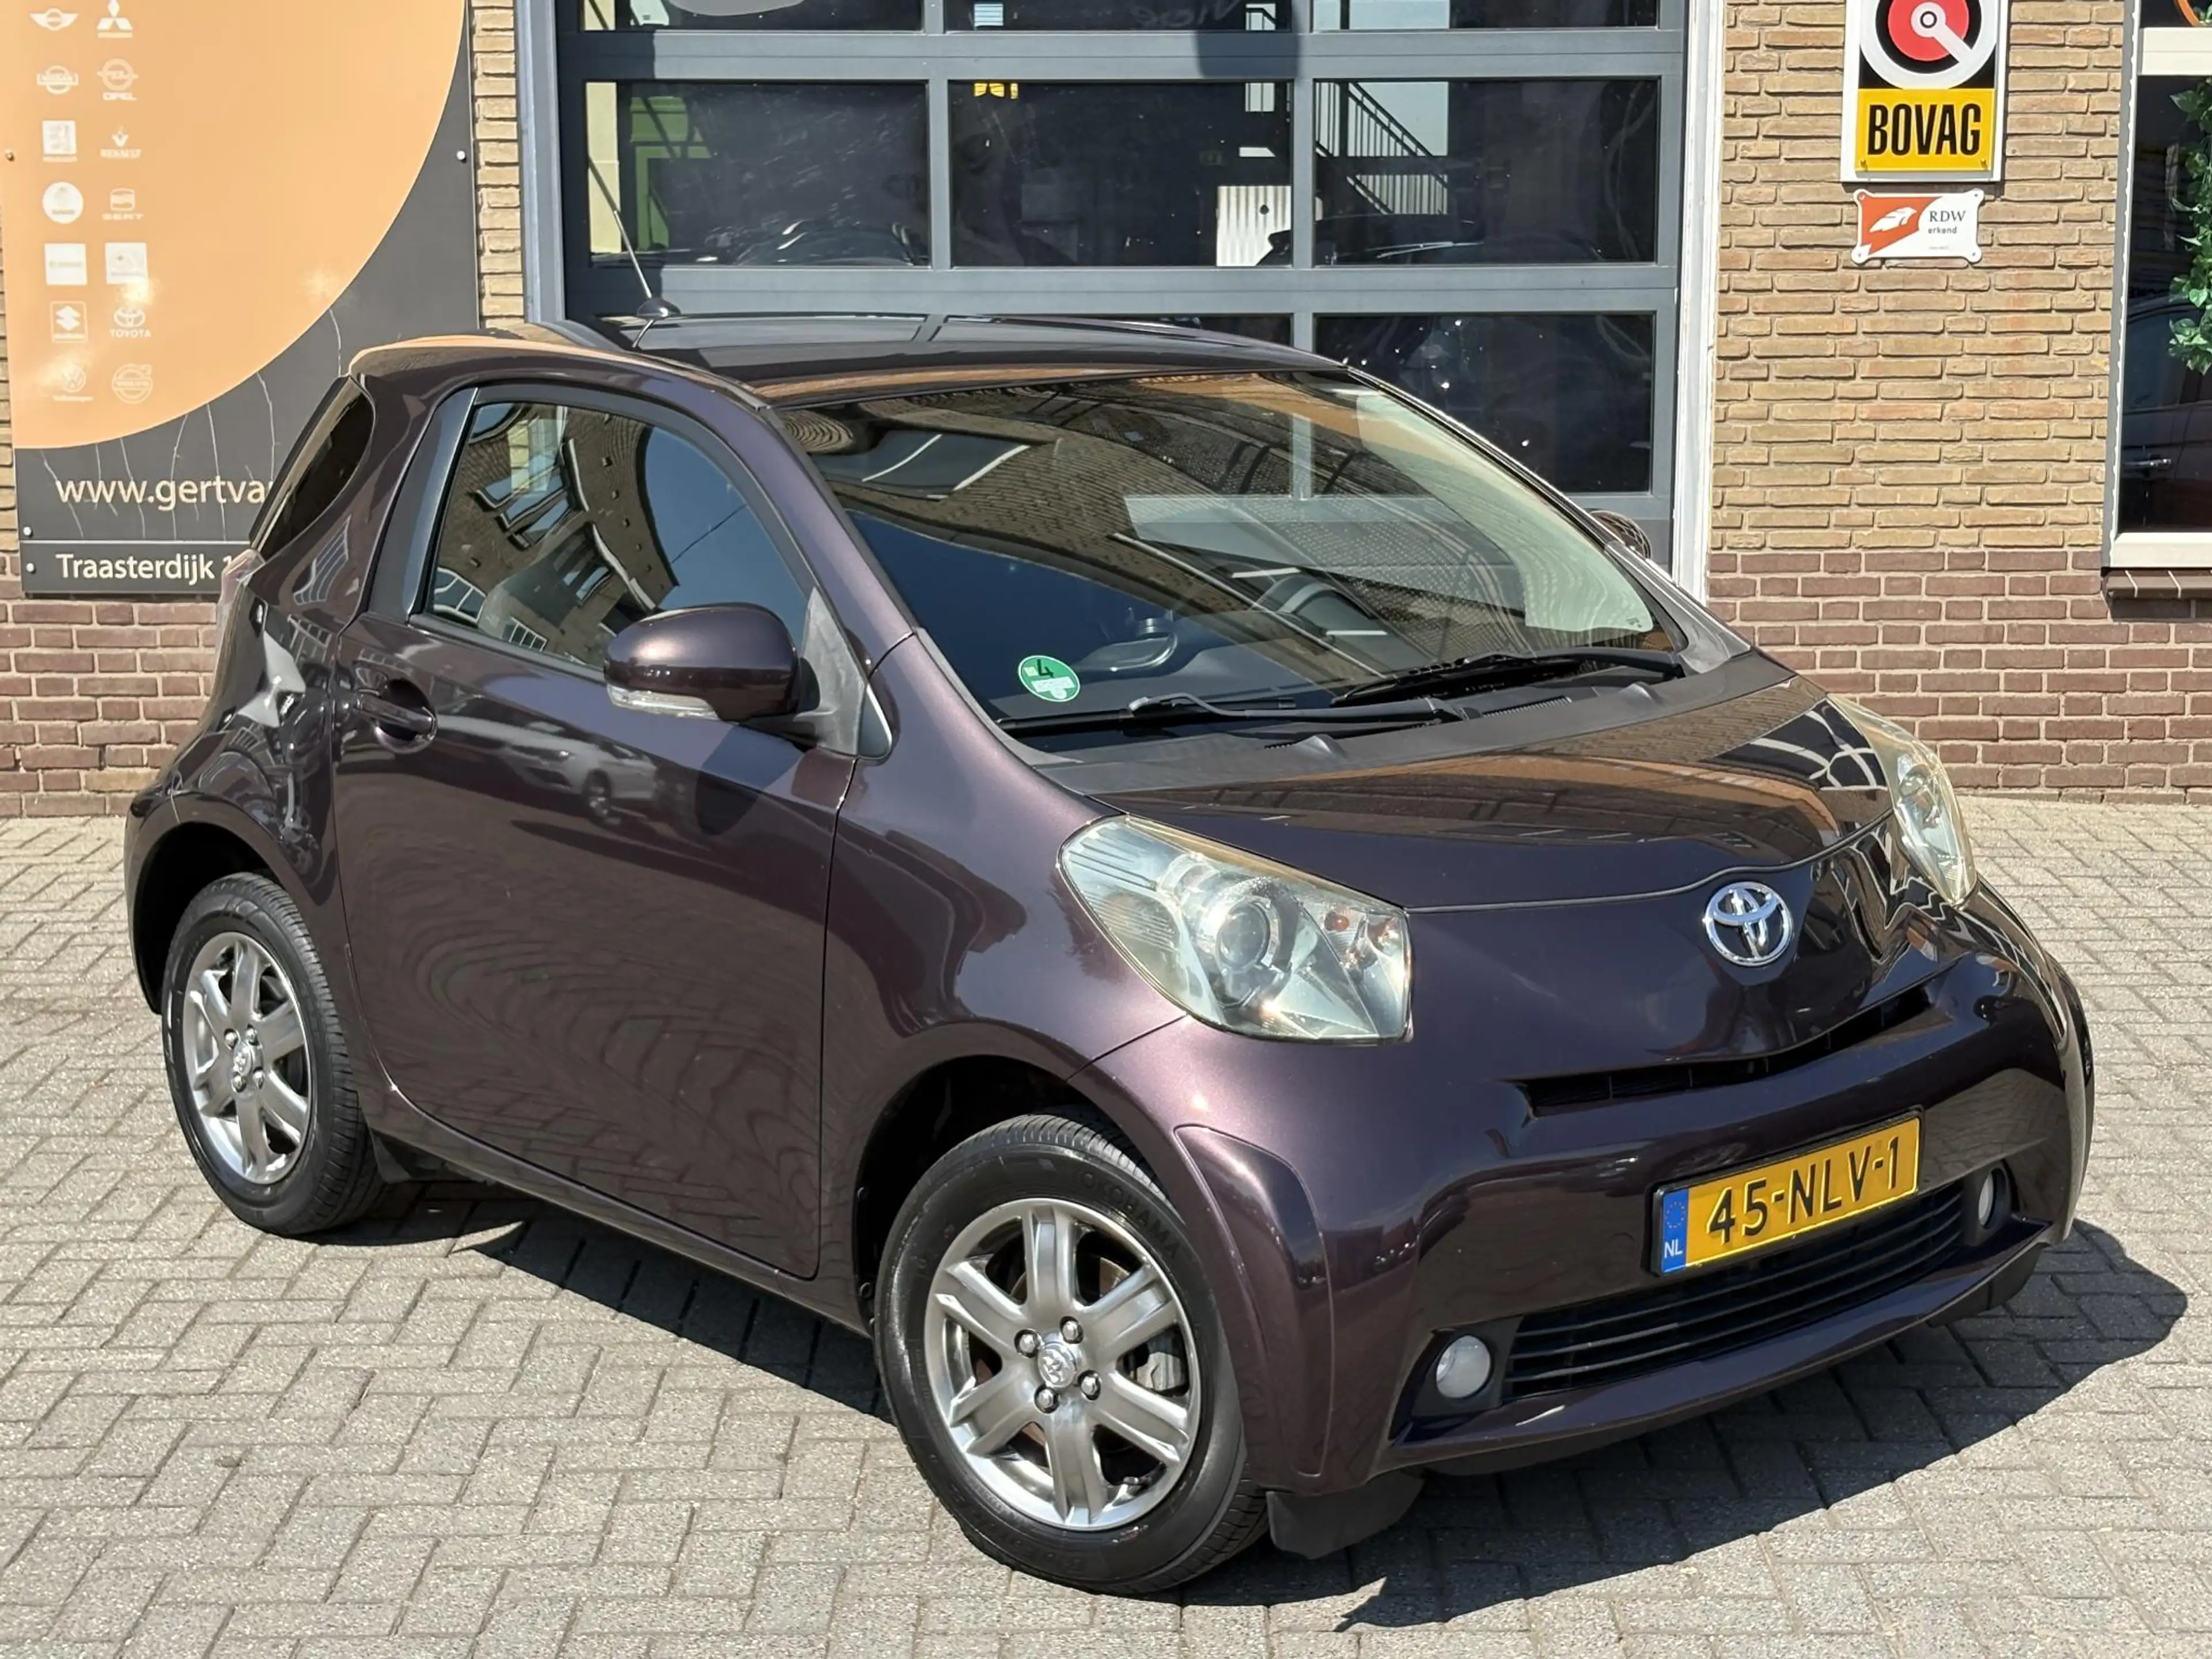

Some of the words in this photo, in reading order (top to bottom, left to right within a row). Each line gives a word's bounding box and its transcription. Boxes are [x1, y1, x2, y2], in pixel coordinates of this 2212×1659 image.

[1867, 103, 1982, 156] BOVAG
[1929, 210, 1967, 222] RDW
[1928, 226, 1957, 234] erkend
[109, 329, 151, 338] TOYOTA
[56, 553, 215, 586] Traasterdijk
[1706, 1137, 1899, 1245] 45-NLV-1
[1664, 1238, 1683, 1259] NL
